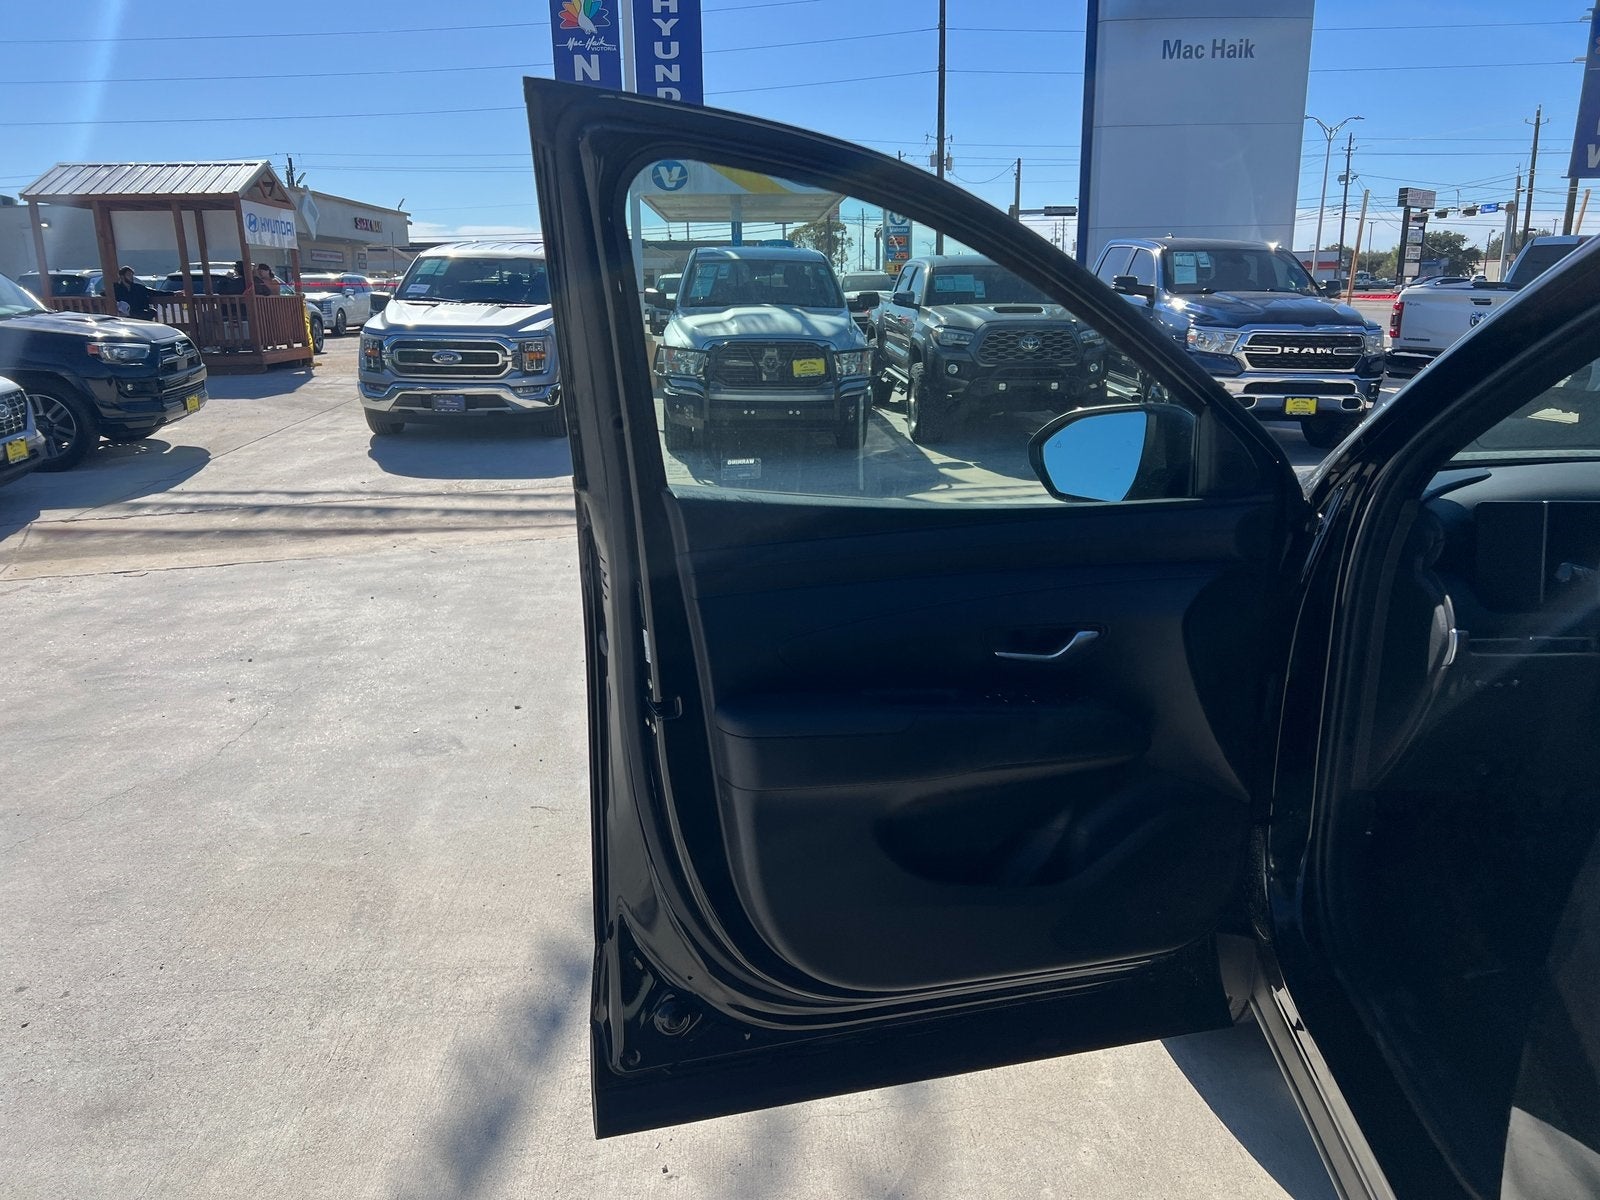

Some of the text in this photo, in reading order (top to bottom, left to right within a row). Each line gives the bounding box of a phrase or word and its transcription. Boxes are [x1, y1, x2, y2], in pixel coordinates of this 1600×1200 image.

[1162, 38, 1255, 60] Mac Haik
[260, 216, 295, 237] HYUNDAI
[1283, 346, 1331, 354] RAM
